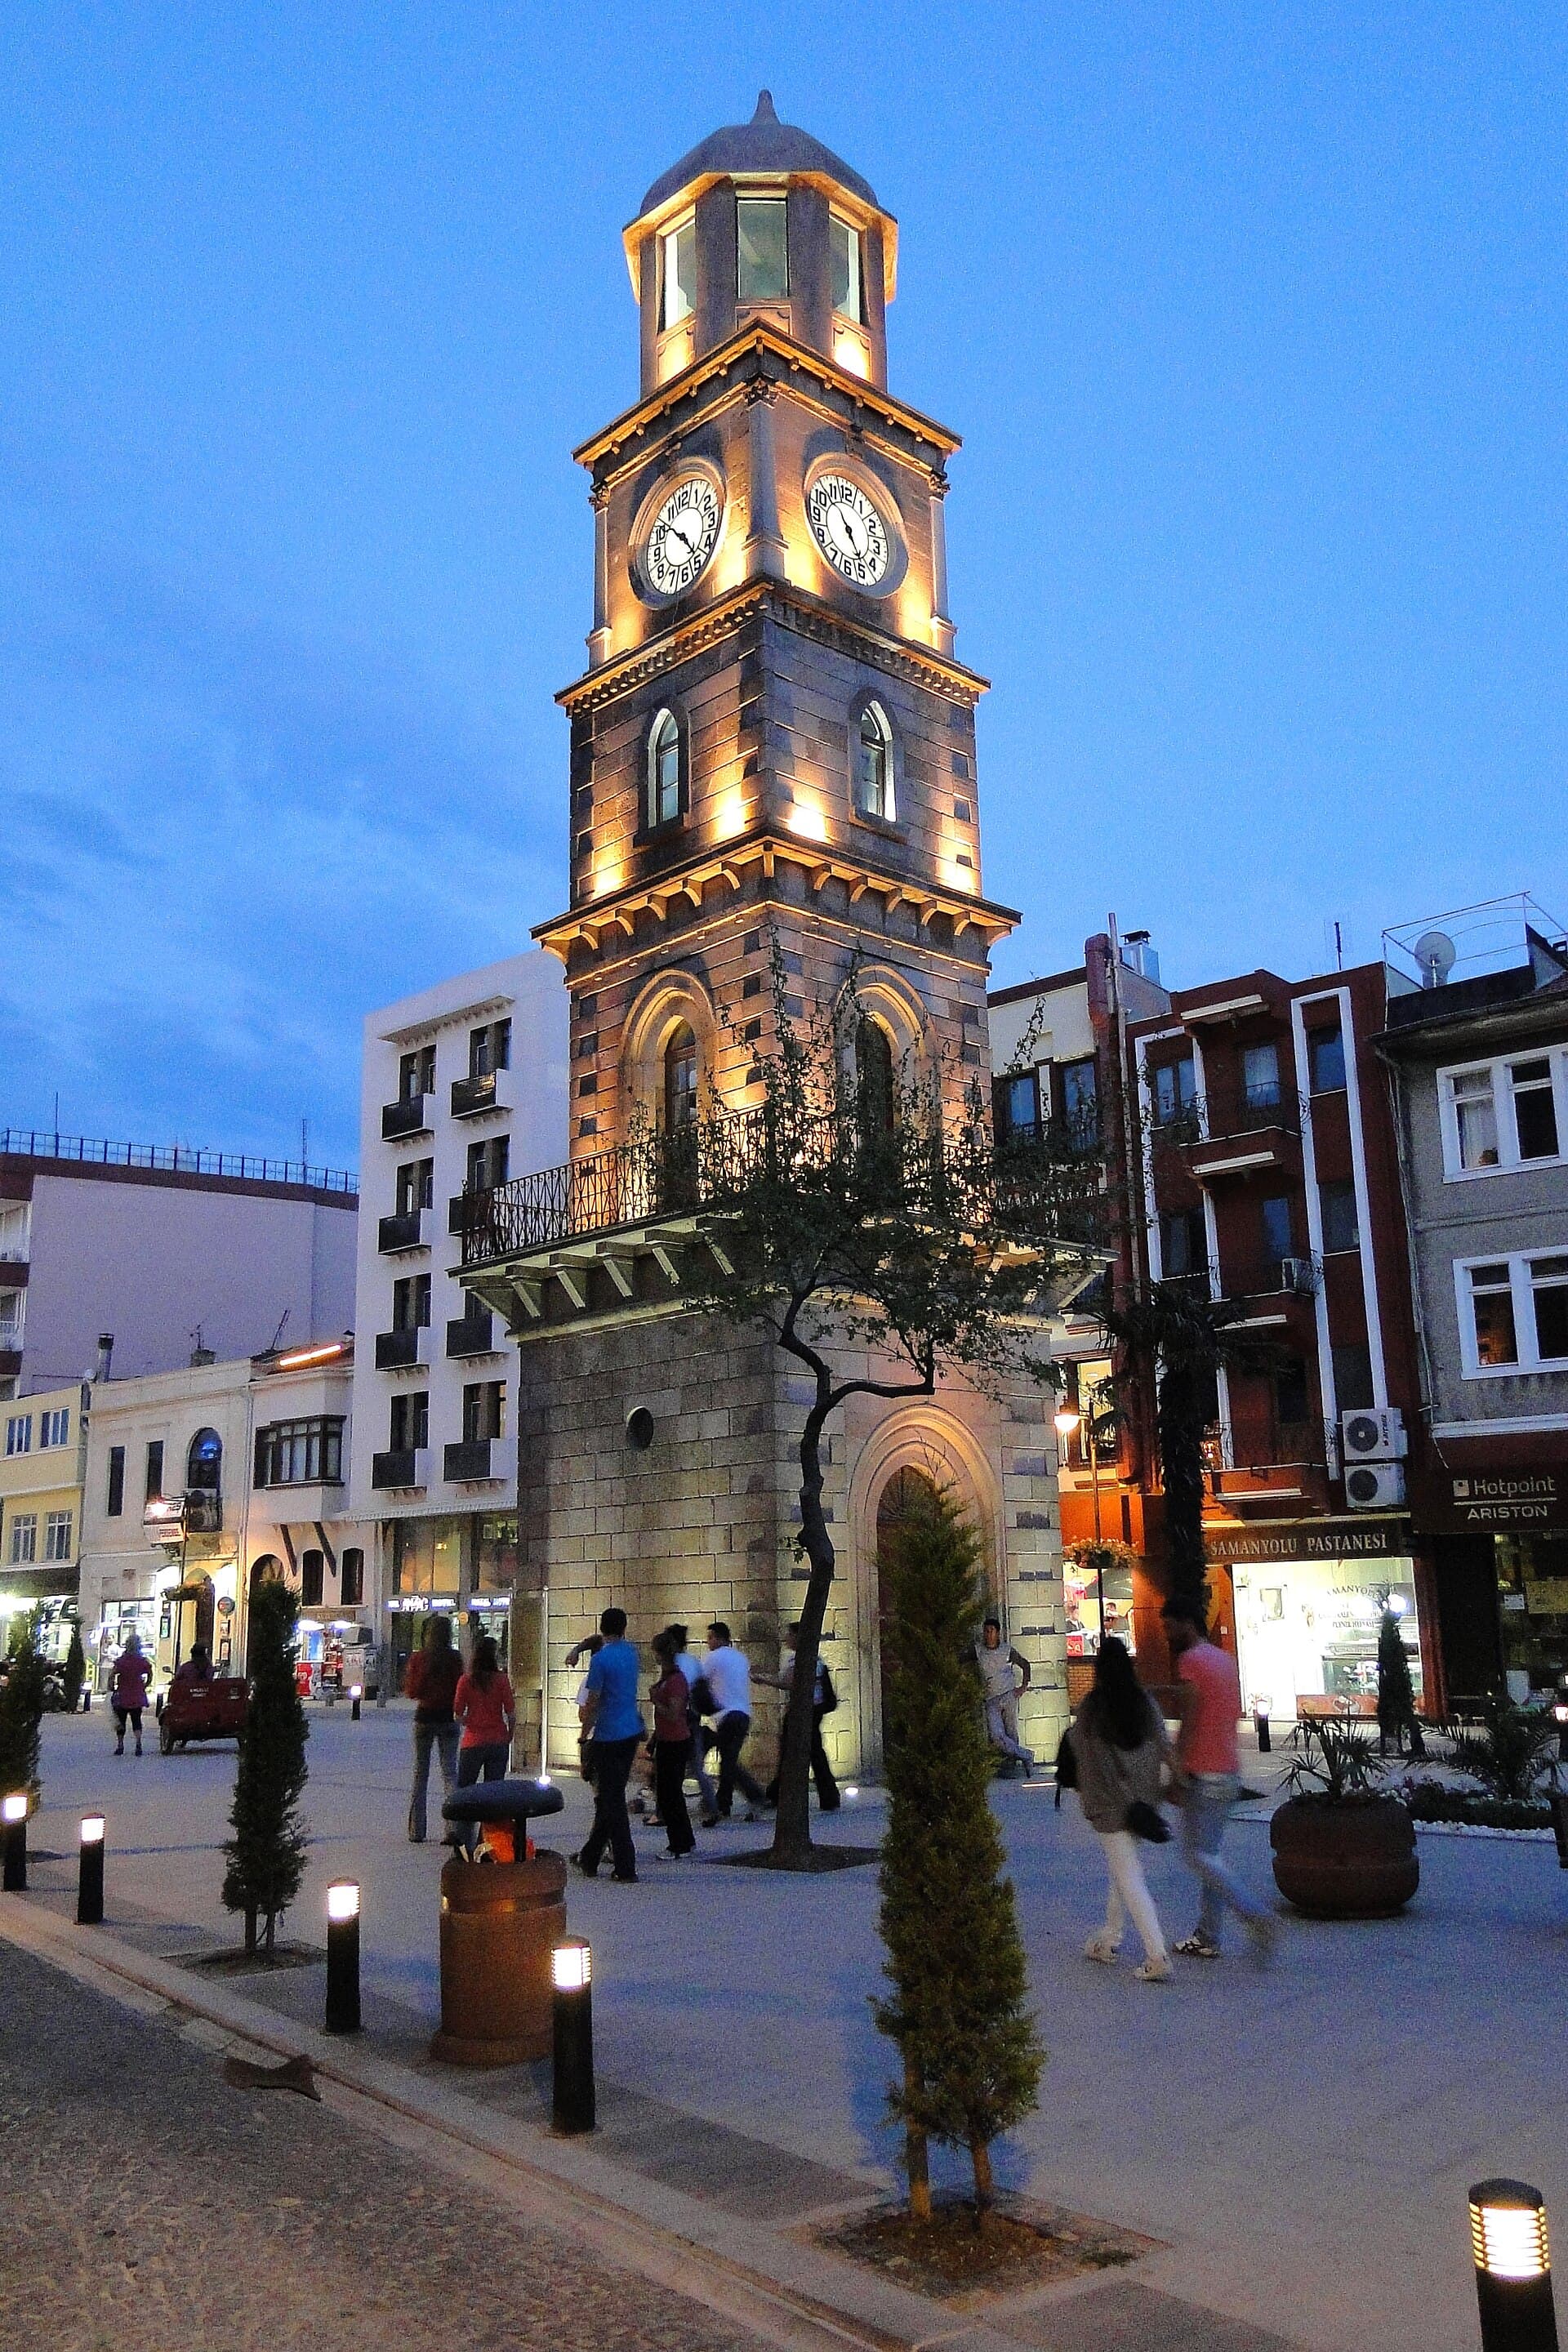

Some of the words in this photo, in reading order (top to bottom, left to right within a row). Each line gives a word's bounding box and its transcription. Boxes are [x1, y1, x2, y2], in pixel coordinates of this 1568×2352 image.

[815, 488, 826, 507] 10
[830, 483, 836, 500] 11
[841, 485, 852, 503] 12
[678, 490, 688, 510] 12
[704, 495, 711, 512] 2
[668, 505, 674, 521] 11
[708, 511, 715, 528] 3
[813, 506, 820, 522] 9
[869, 519, 875, 535] 2
[704, 533, 712, 549] 4
[817, 528, 825, 543] 8
[654, 546, 660, 562] 9
[831, 547, 838, 561] 7
[873, 540, 880, 555] 3
[694, 554, 701, 571] 5
[844, 559, 851, 576] 6
[869, 557, 875, 572] 4
[657, 564, 664, 580] 8
[669, 570, 675, 586] 7
[682, 567, 688, 583] 6
[858, 563, 865, 579] 5
[1474, 1477, 1555, 1497] Hotpoint
[1468, 1505, 1548, 1520] ARISTON
[1210, 1539, 1297, 1556] SAMANYOLU
